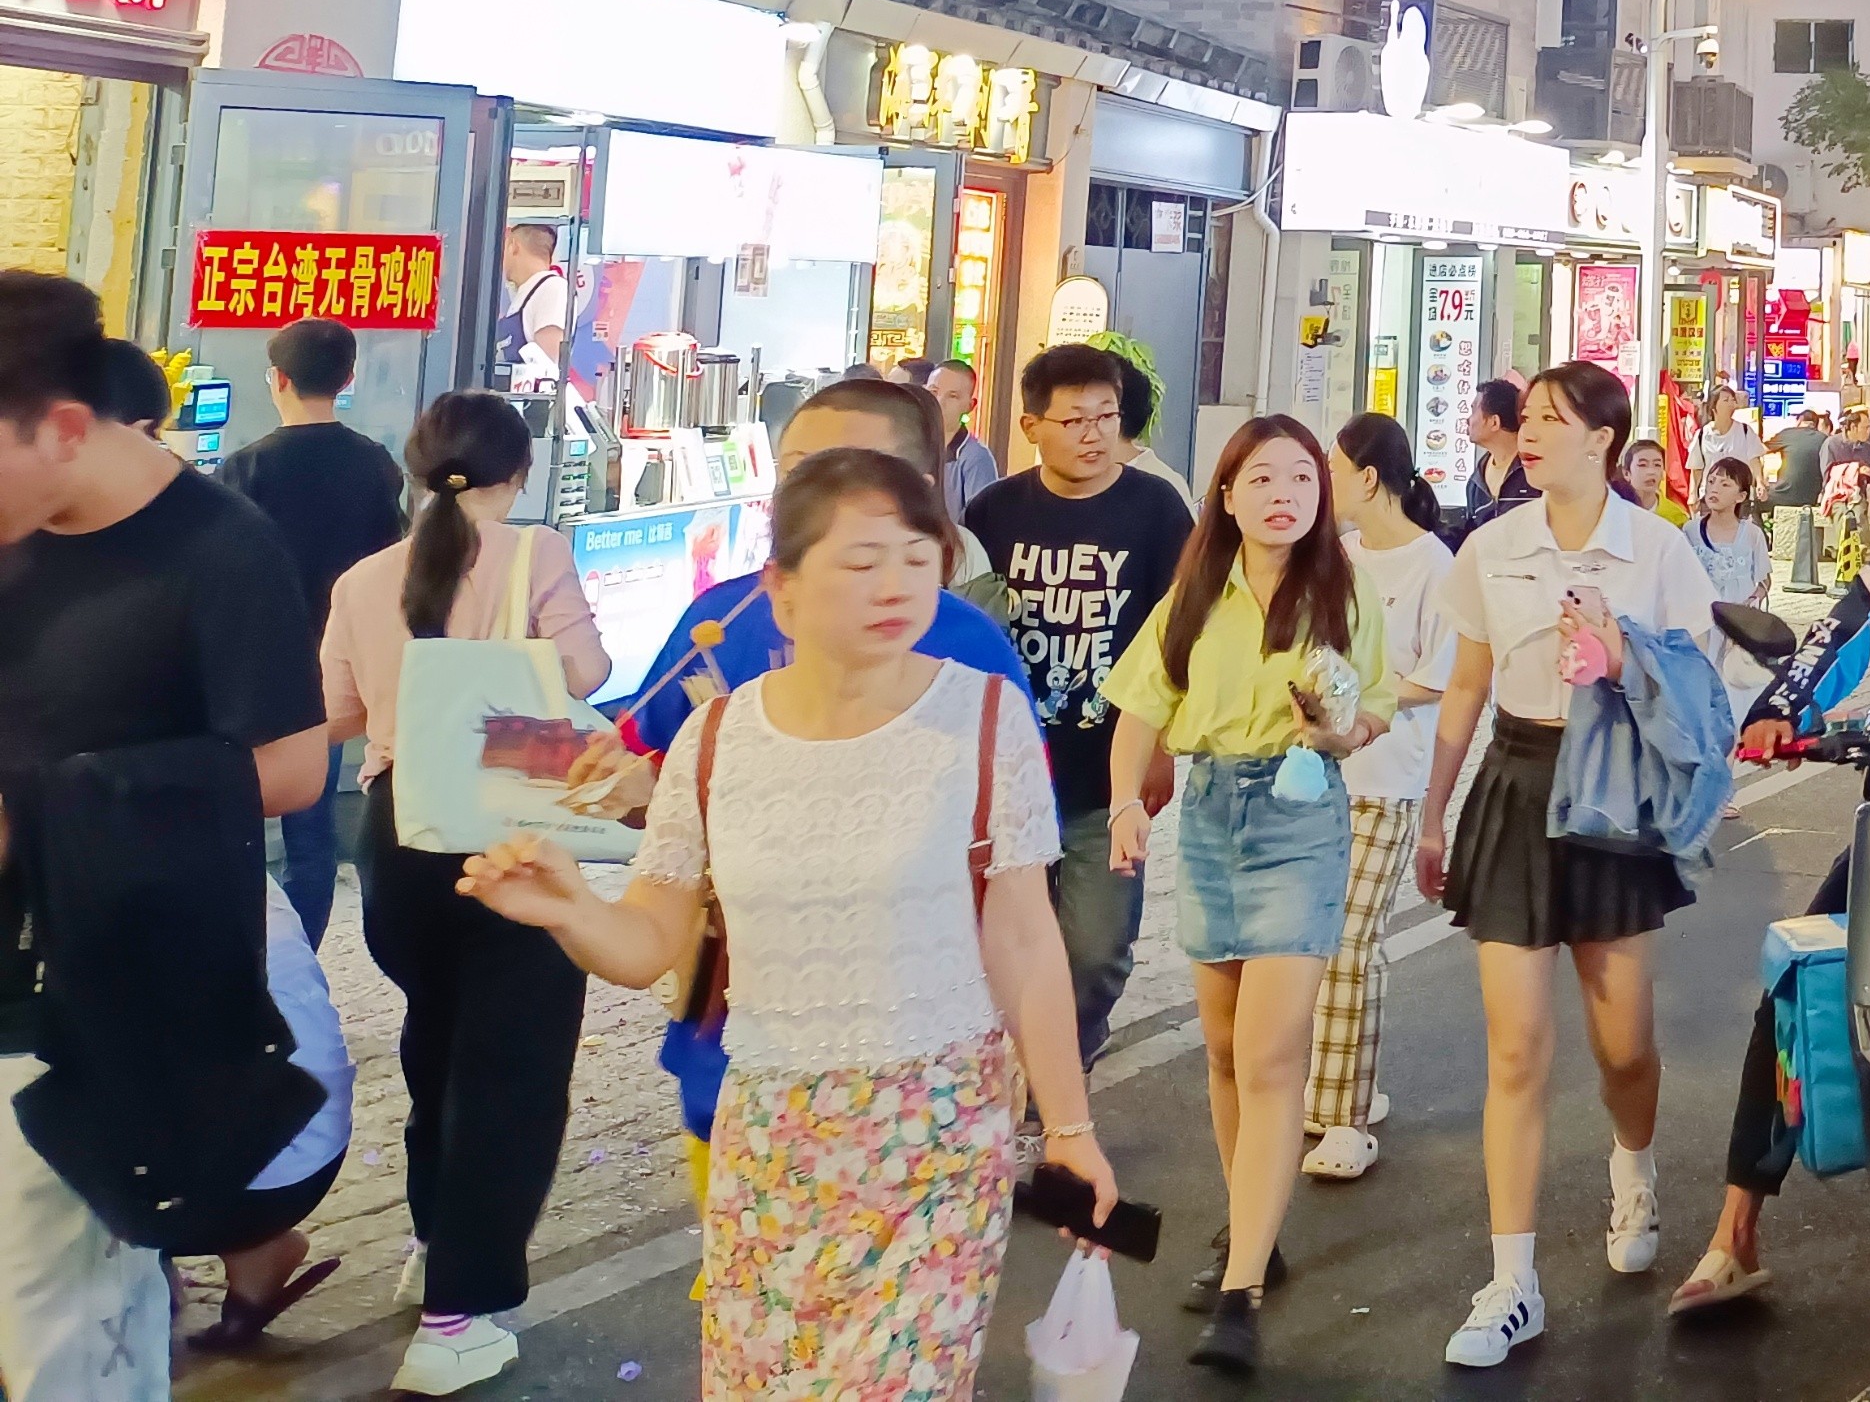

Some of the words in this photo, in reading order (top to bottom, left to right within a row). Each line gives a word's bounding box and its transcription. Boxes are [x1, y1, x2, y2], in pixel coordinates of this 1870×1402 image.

[197, 241, 435, 319] 正宗台湾无骨鸡柳
[1439, 289, 1463, 322] 7.9
[585, 529, 623, 552] Better
[623, 529, 643, 546] me
[1009, 542, 1129, 587] HUEY
[1007, 587, 1131, 628] DEWEY
